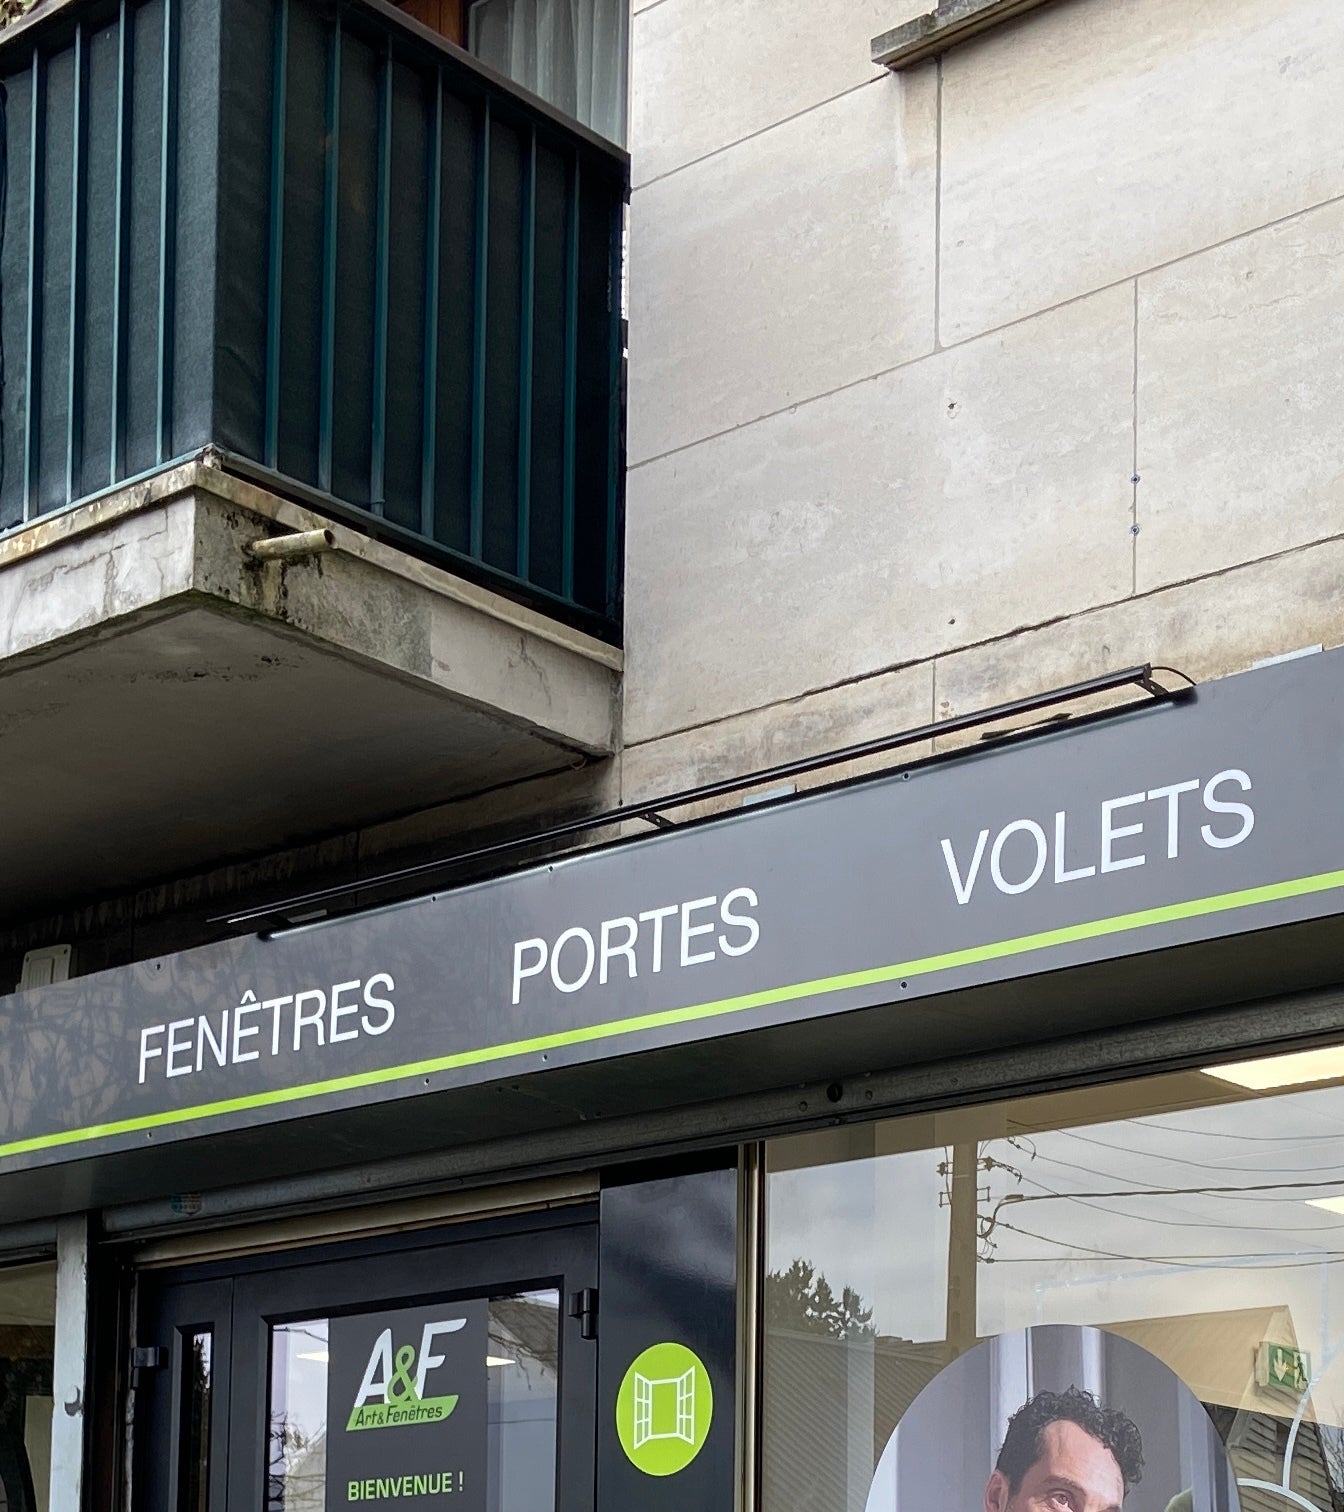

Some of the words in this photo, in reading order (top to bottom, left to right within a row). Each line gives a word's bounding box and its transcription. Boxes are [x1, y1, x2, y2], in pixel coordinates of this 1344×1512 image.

[940, 768, 1256, 905] VOLETS
[511, 886, 761, 1005] PORTES
[137, 972, 397, 1083] FENÊTRES
[354, 1318, 467, 1408] A&F
[347, 1472, 453, 1501] BIENVENUE
[458, 1471, 464, 1492] !
